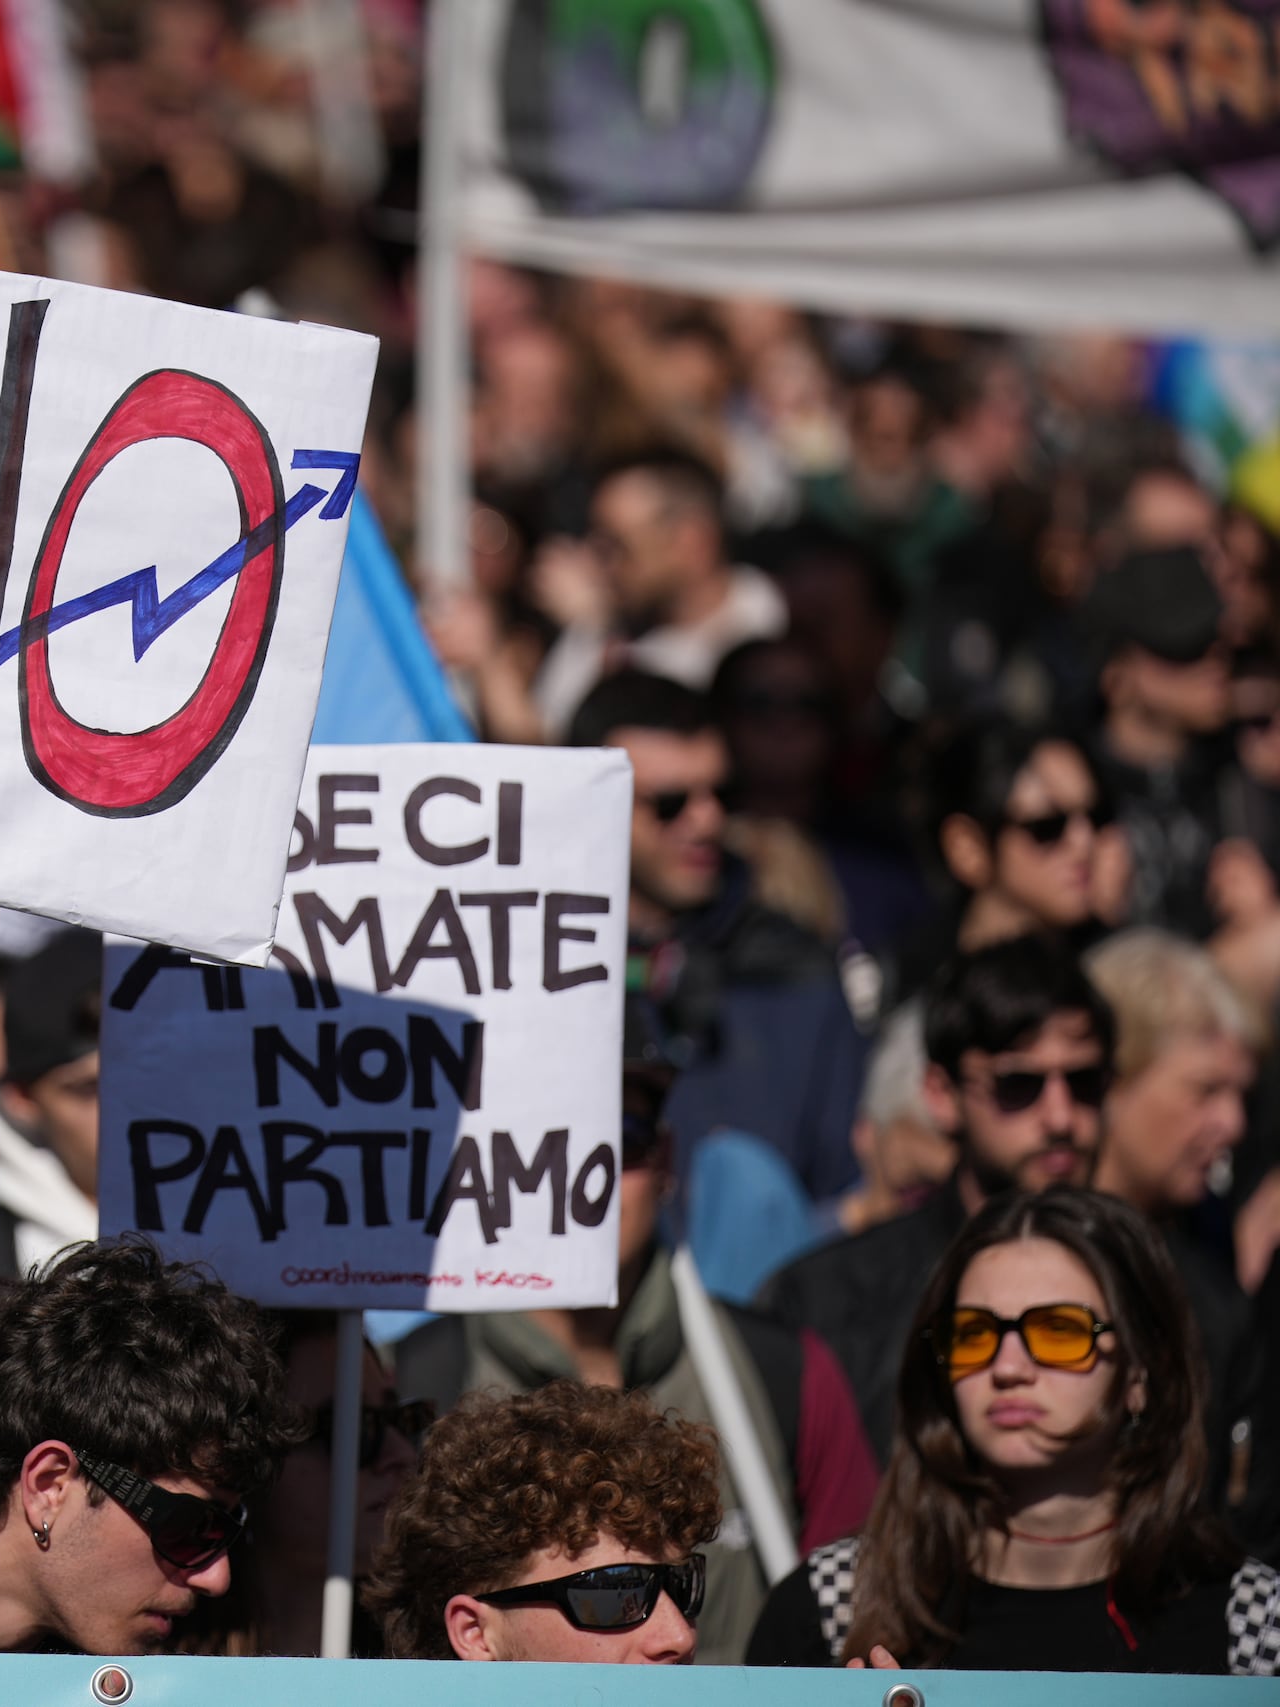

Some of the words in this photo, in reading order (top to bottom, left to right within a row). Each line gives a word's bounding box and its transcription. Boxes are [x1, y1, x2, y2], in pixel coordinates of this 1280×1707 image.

[404, 776, 523, 866] CI
[253, 1014, 485, 1111] NON
[127, 1119, 617, 1244] PARTIAMO
